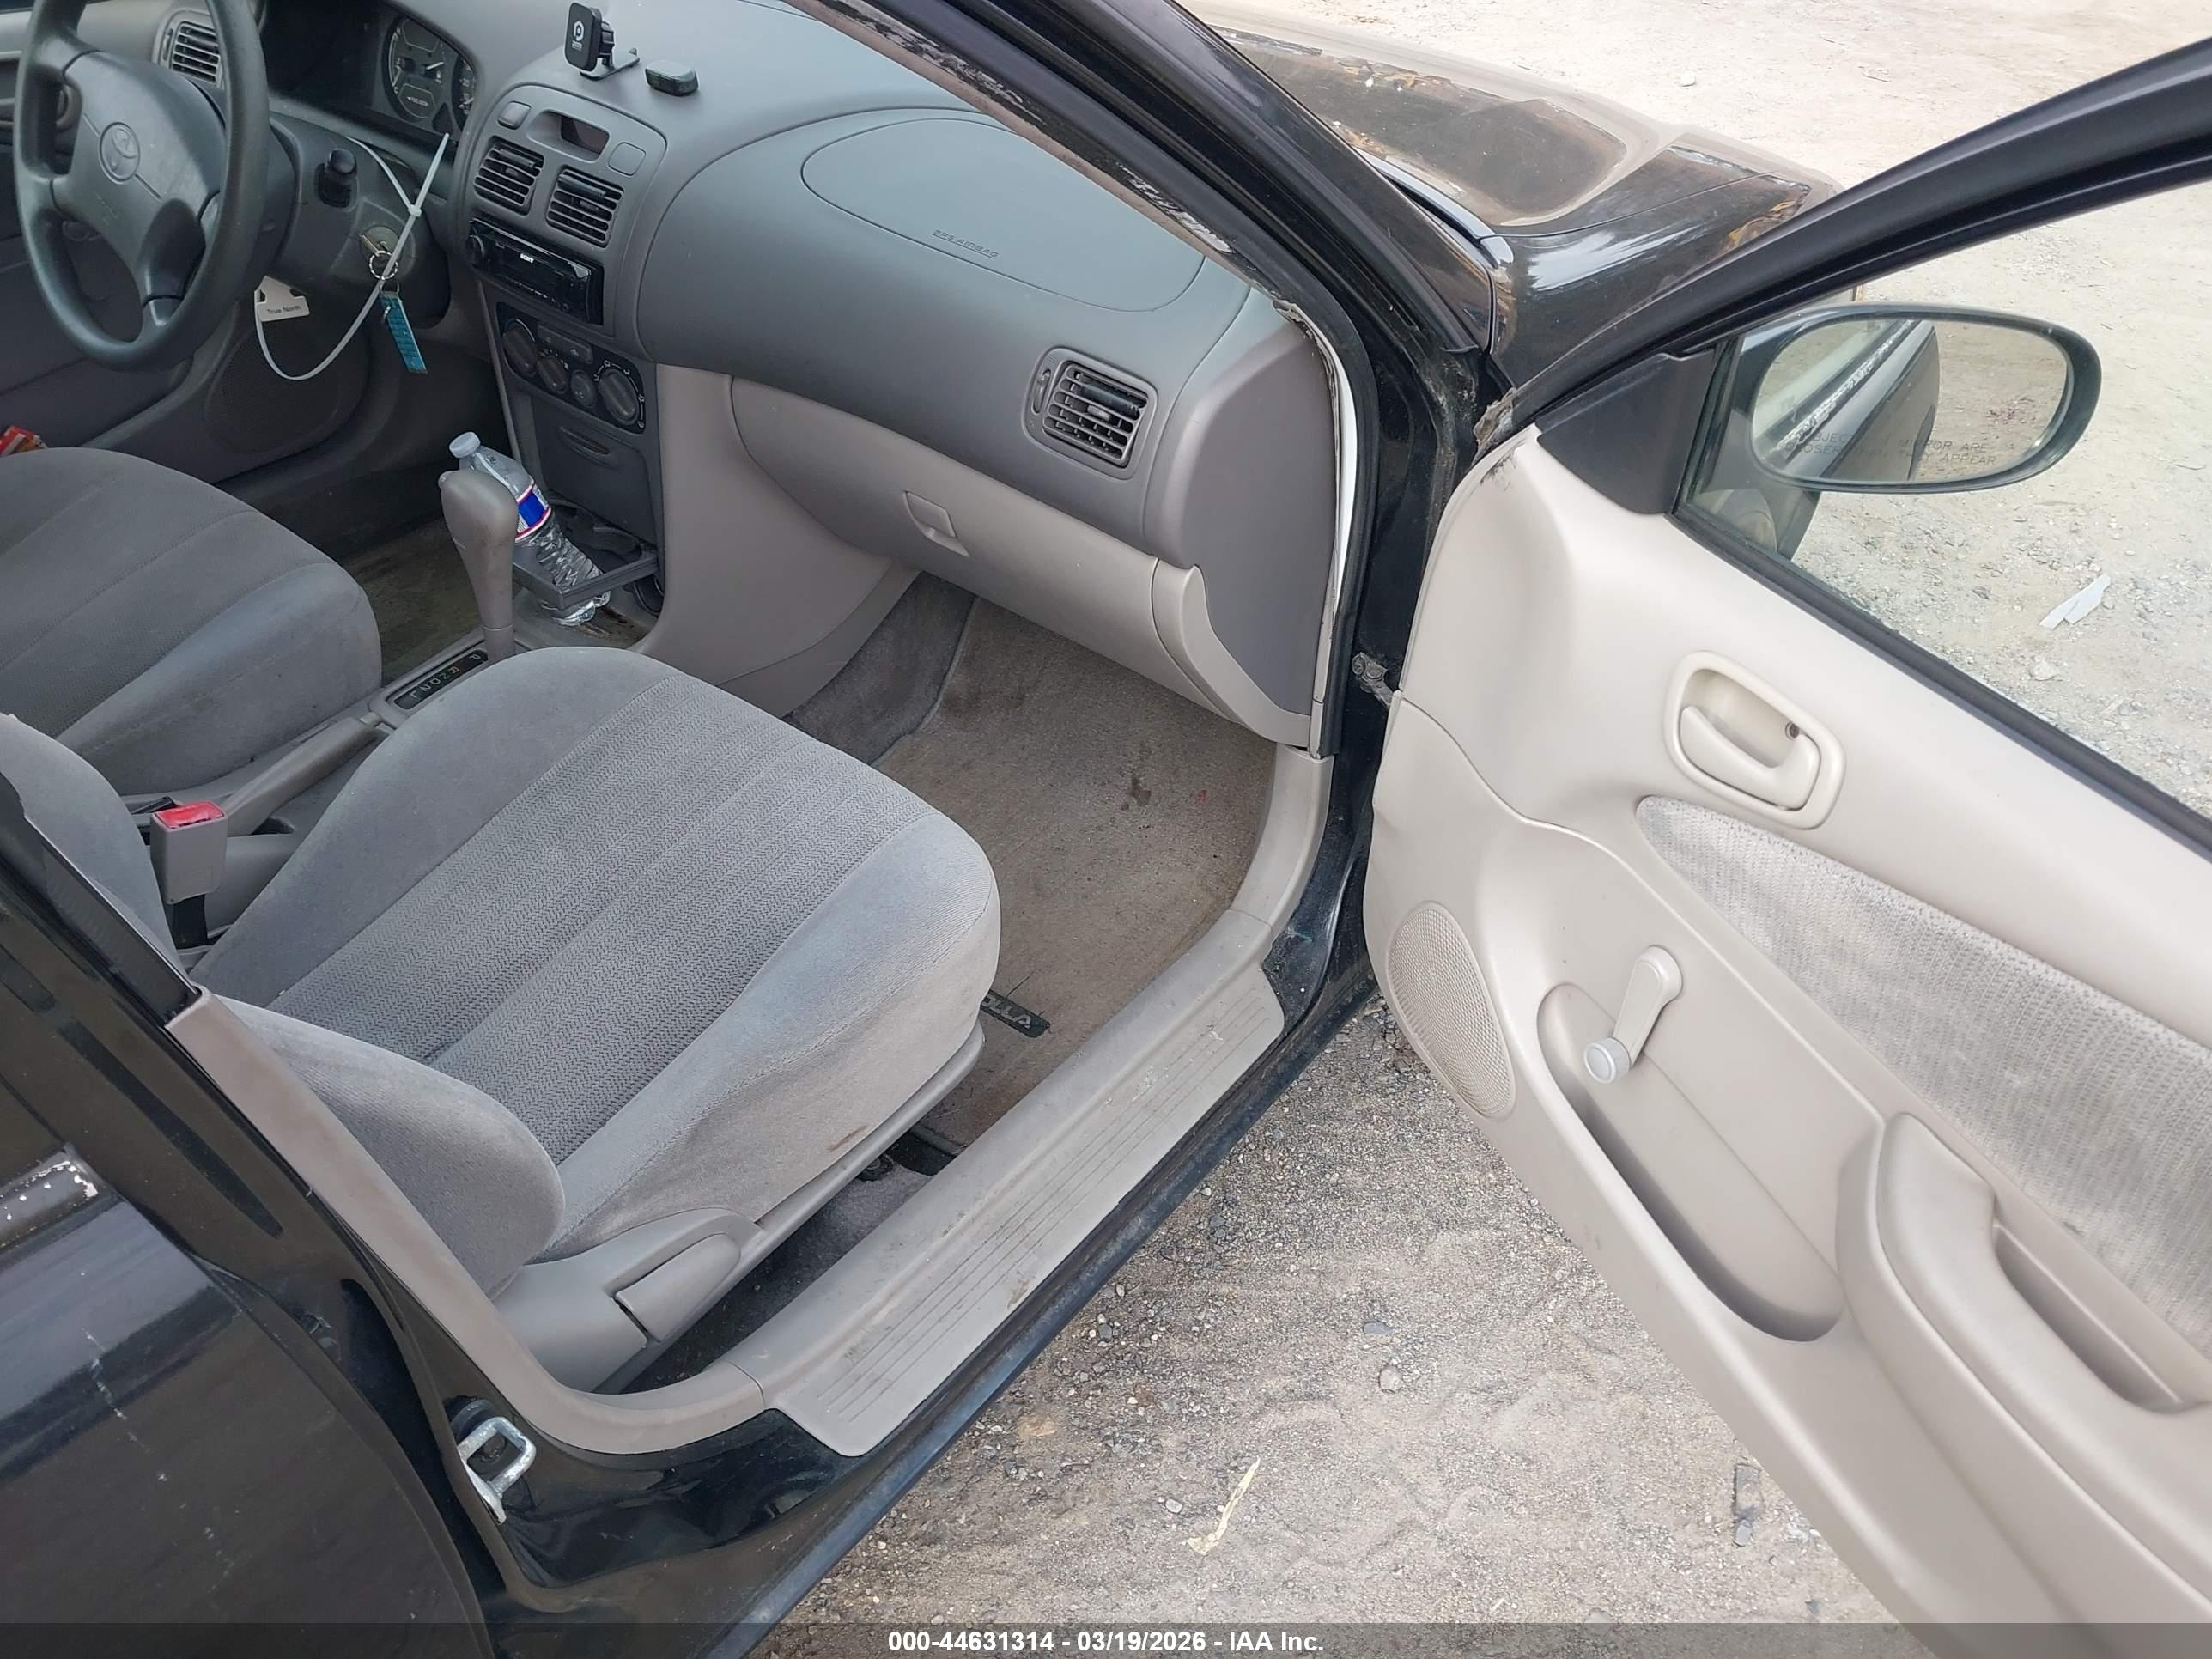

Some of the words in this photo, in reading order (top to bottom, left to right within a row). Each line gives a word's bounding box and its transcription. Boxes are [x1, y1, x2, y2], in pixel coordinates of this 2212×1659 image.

[933, 228, 956, 240] SRS
[956, 239, 1000, 258] AIRBAG
[266, 307, 283, 315] True
[283, 303, 302, 313] North
[1784, 441, 1842, 455] COSER
[1940, 453, 1997, 466] APPEAR
[1897, 439, 1953, 452] MIROR
[1960, 441, 1988, 453] ARE
[448, 665, 460, 674] R
[981, 994, 1031, 1030] OLLA
